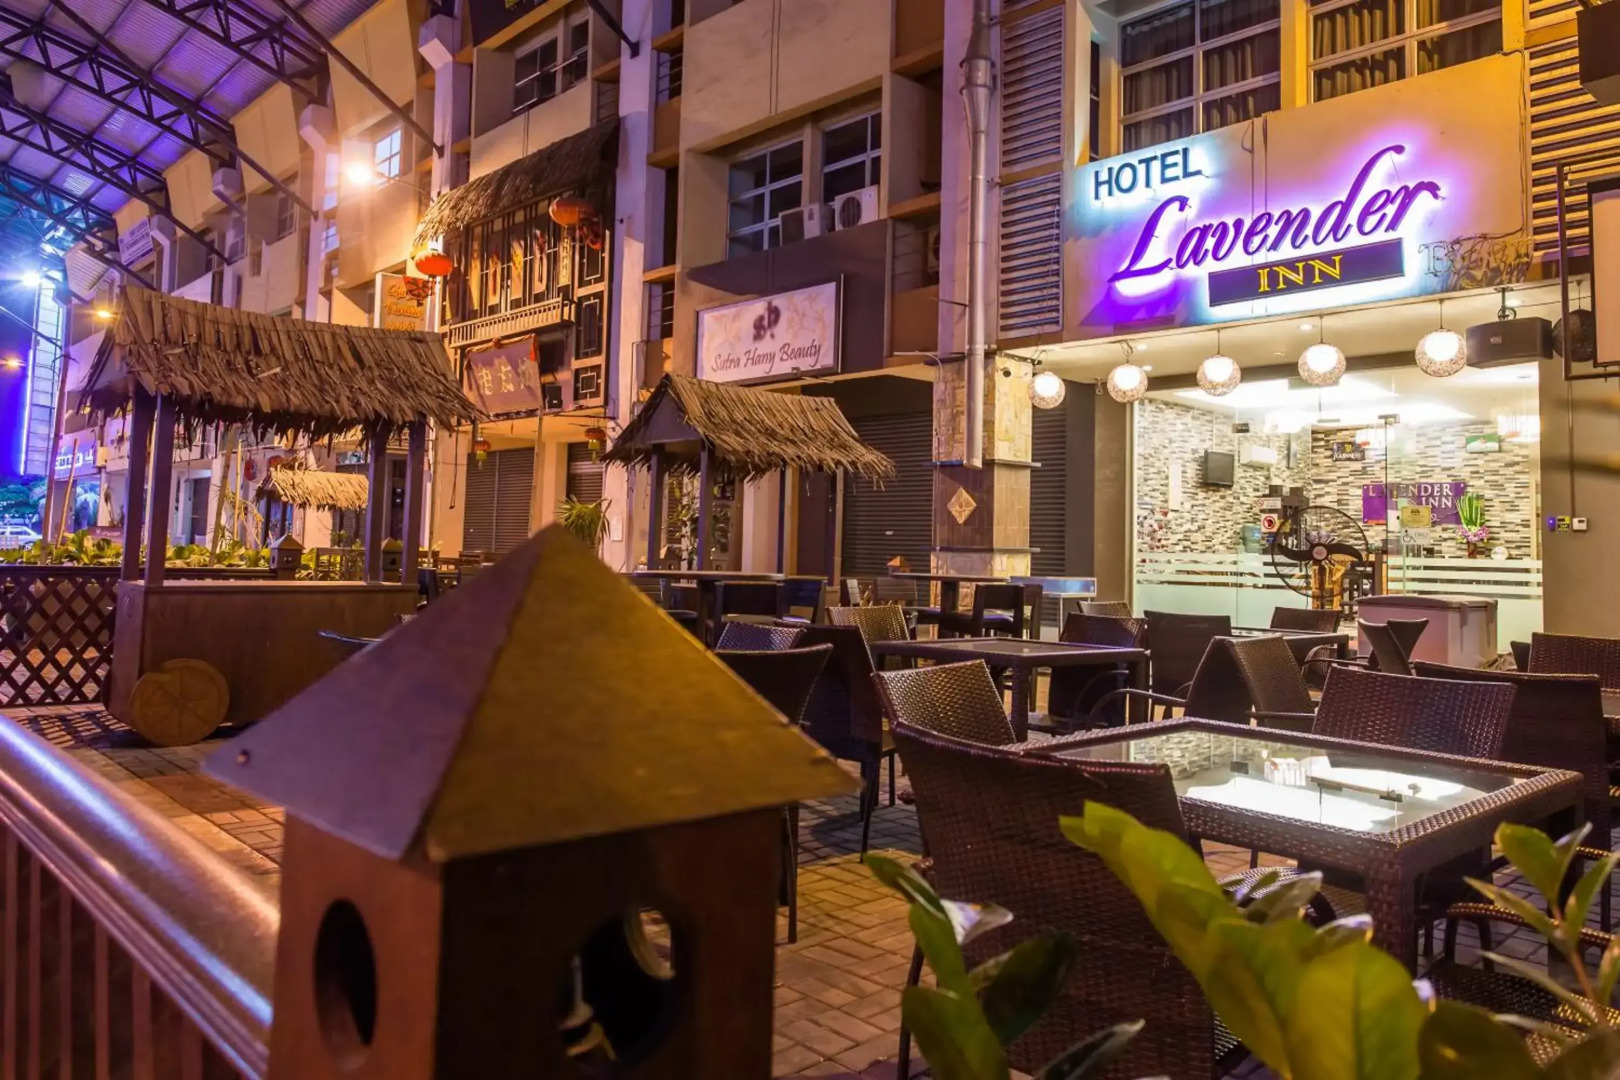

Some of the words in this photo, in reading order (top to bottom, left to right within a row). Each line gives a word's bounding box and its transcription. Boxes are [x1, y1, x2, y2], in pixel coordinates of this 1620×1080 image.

[1093, 146, 1203, 200] HOTEL
[1106, 144, 1442, 284] Lavender
[1257, 255, 1343, 293] INN
[711, 352, 741, 373] Sutra
[779, 338, 822, 368] Beauty
[1421, 496, 1453, 509] INN
